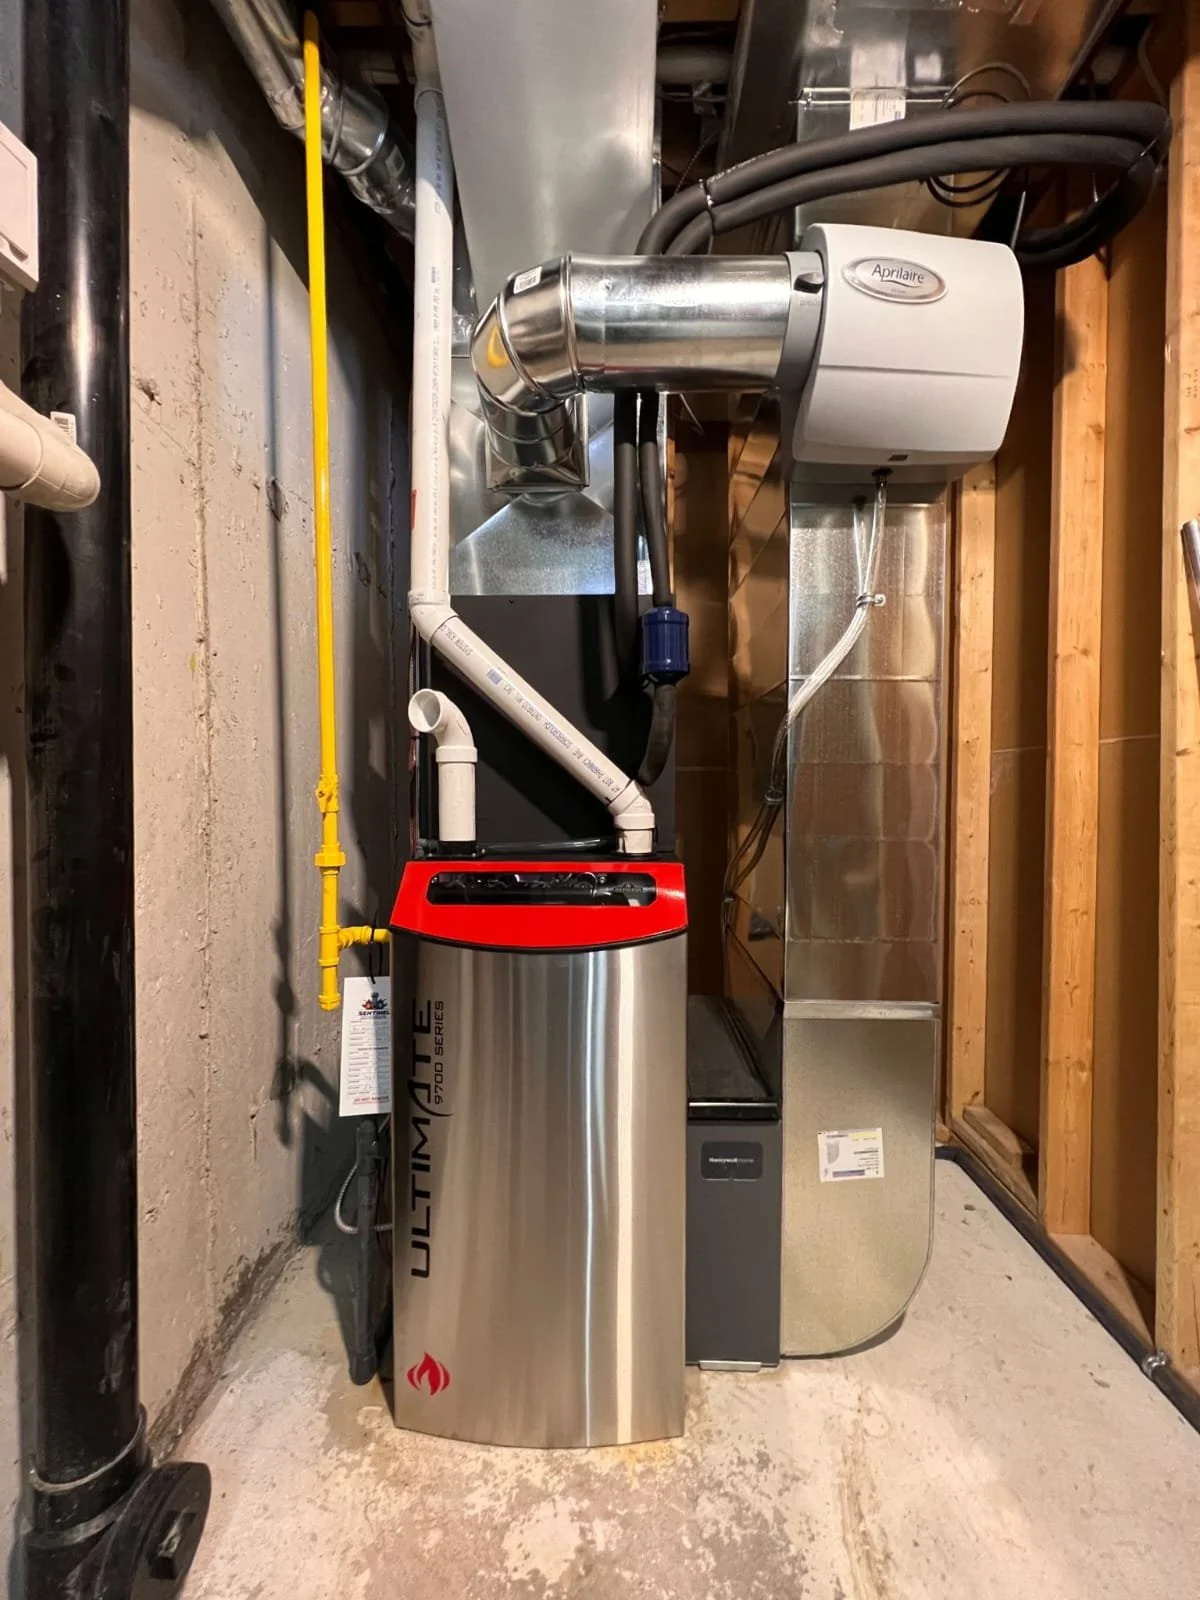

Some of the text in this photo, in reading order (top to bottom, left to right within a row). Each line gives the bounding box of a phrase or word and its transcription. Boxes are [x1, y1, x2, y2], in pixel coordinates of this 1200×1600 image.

[872, 264, 924, 284] Aprilaire
[434, 1001, 443, 1105] 9700 SERIES
[408, 1000, 452, 1278] ULTIMATE
